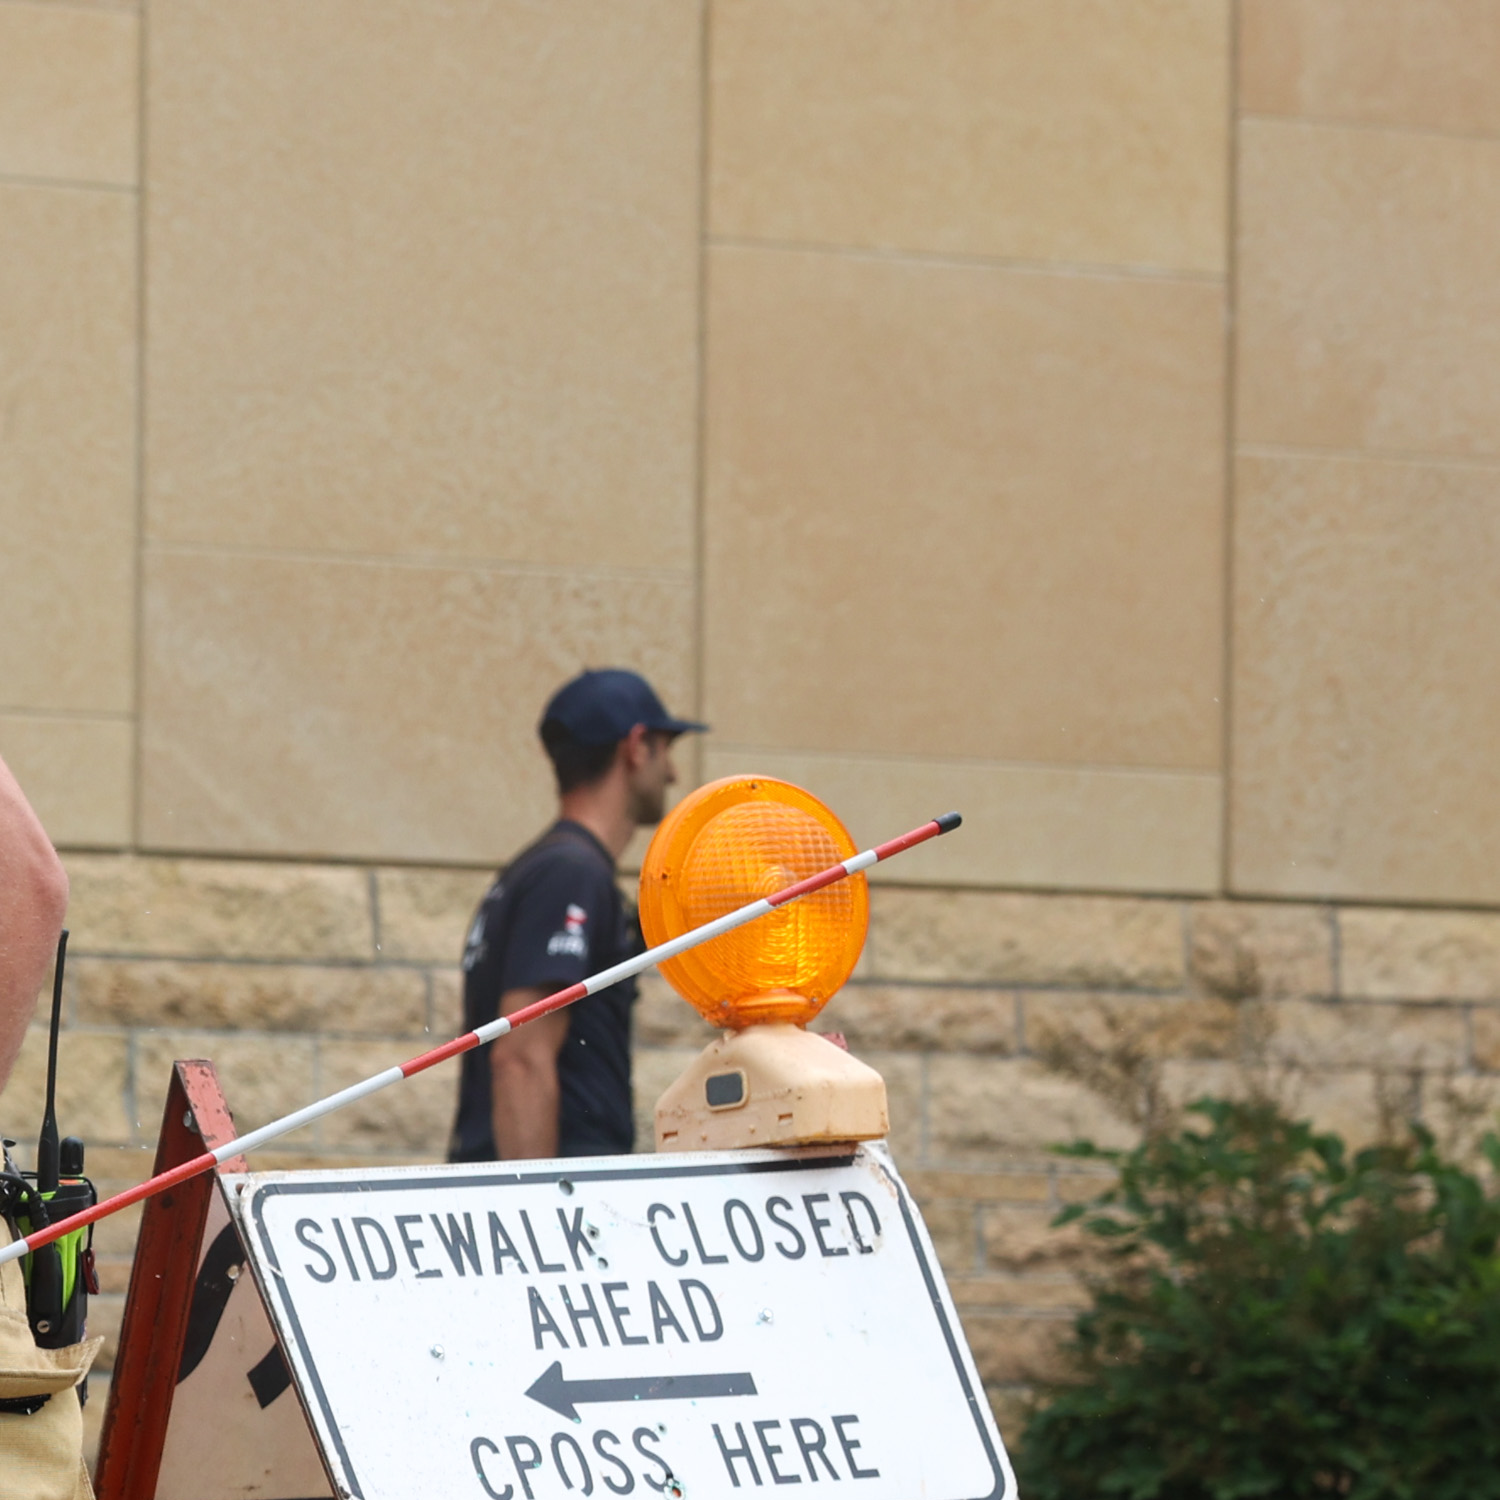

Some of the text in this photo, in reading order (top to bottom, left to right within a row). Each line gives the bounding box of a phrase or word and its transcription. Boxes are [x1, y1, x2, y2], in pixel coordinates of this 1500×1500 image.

[294, 1190, 882, 1284] SIDEWALK CLOSED
[526, 1278, 725, 1350] AHEAD
[710, 1414, 881, 1488] HERE
